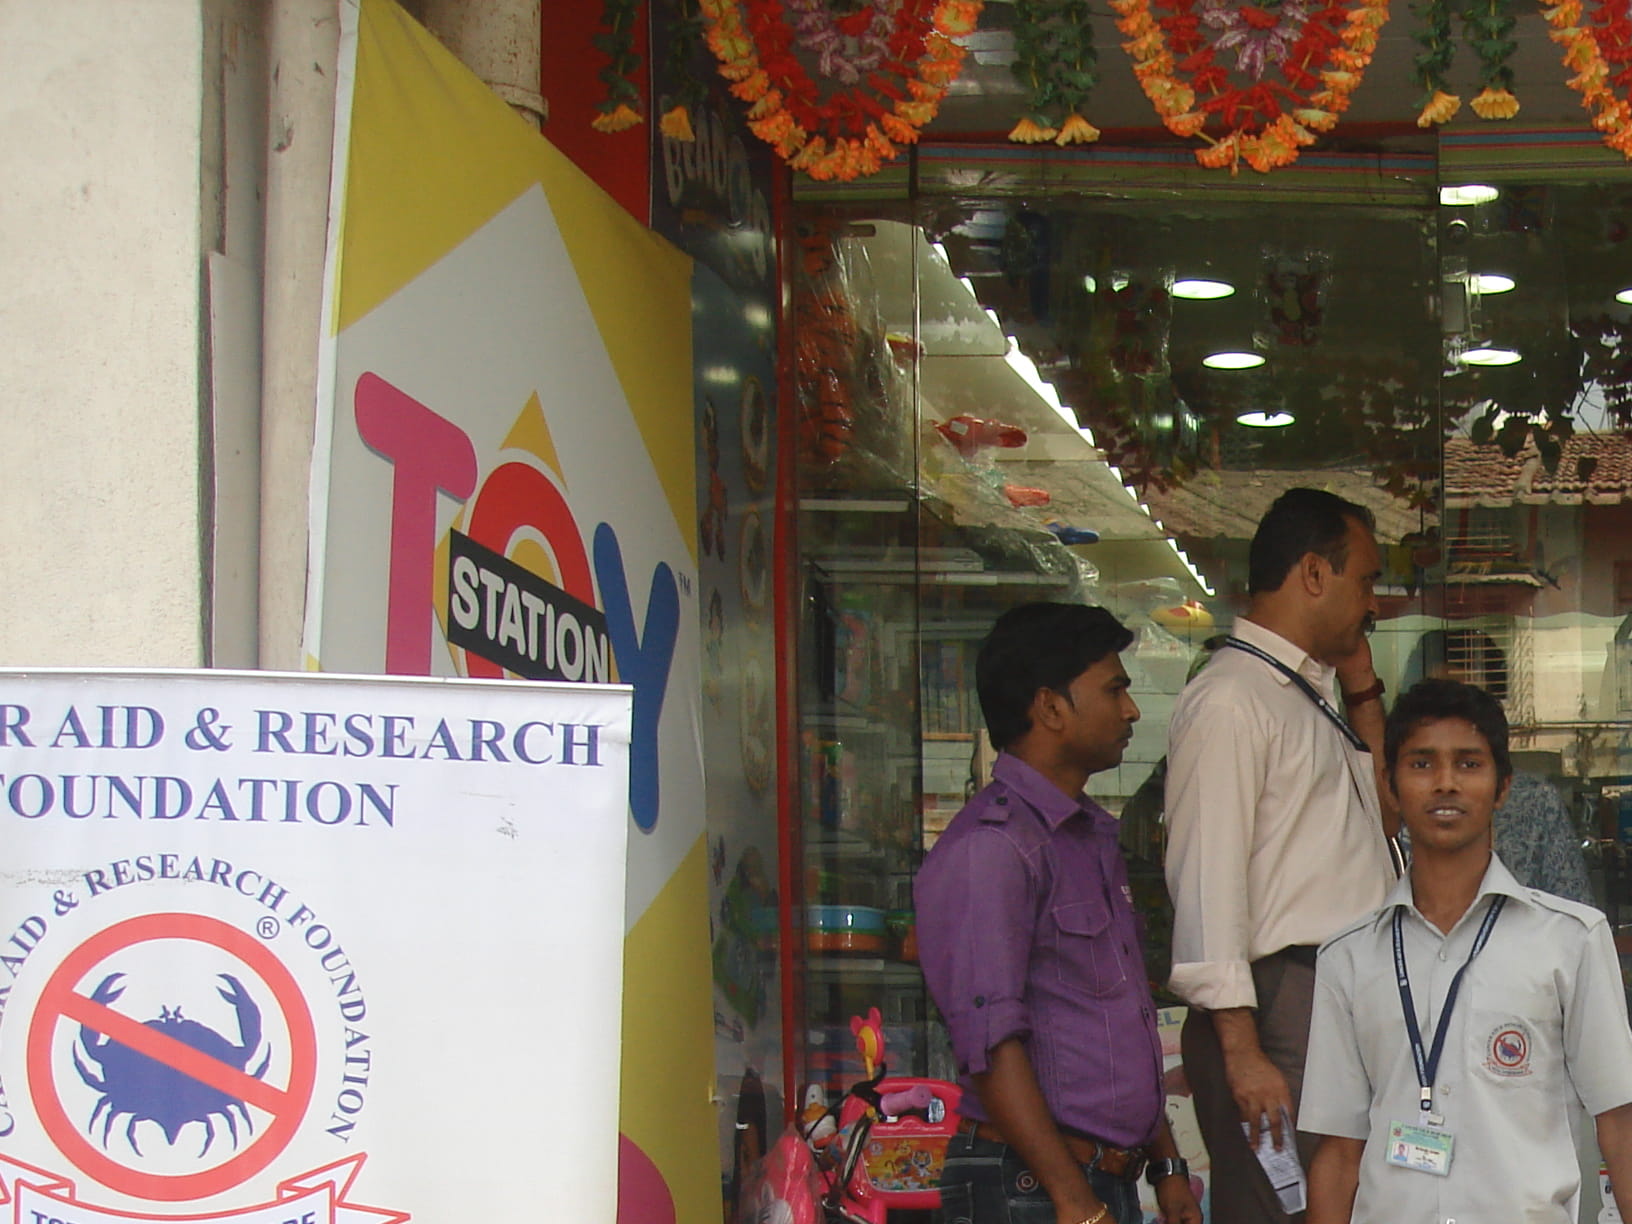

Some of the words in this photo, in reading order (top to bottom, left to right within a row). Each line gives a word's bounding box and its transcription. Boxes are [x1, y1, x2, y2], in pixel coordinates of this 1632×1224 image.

[450, 554, 610, 684] STATION
[49, 705, 164, 749] AID
[184, 707, 232, 752] &
[252, 710, 604, 767] RESEARCH
[0, 773, 400, 828] OUNDATION
[84, 853, 288, 913] RESEARCH
[285, 904, 371, 1142] FOUNDATION
